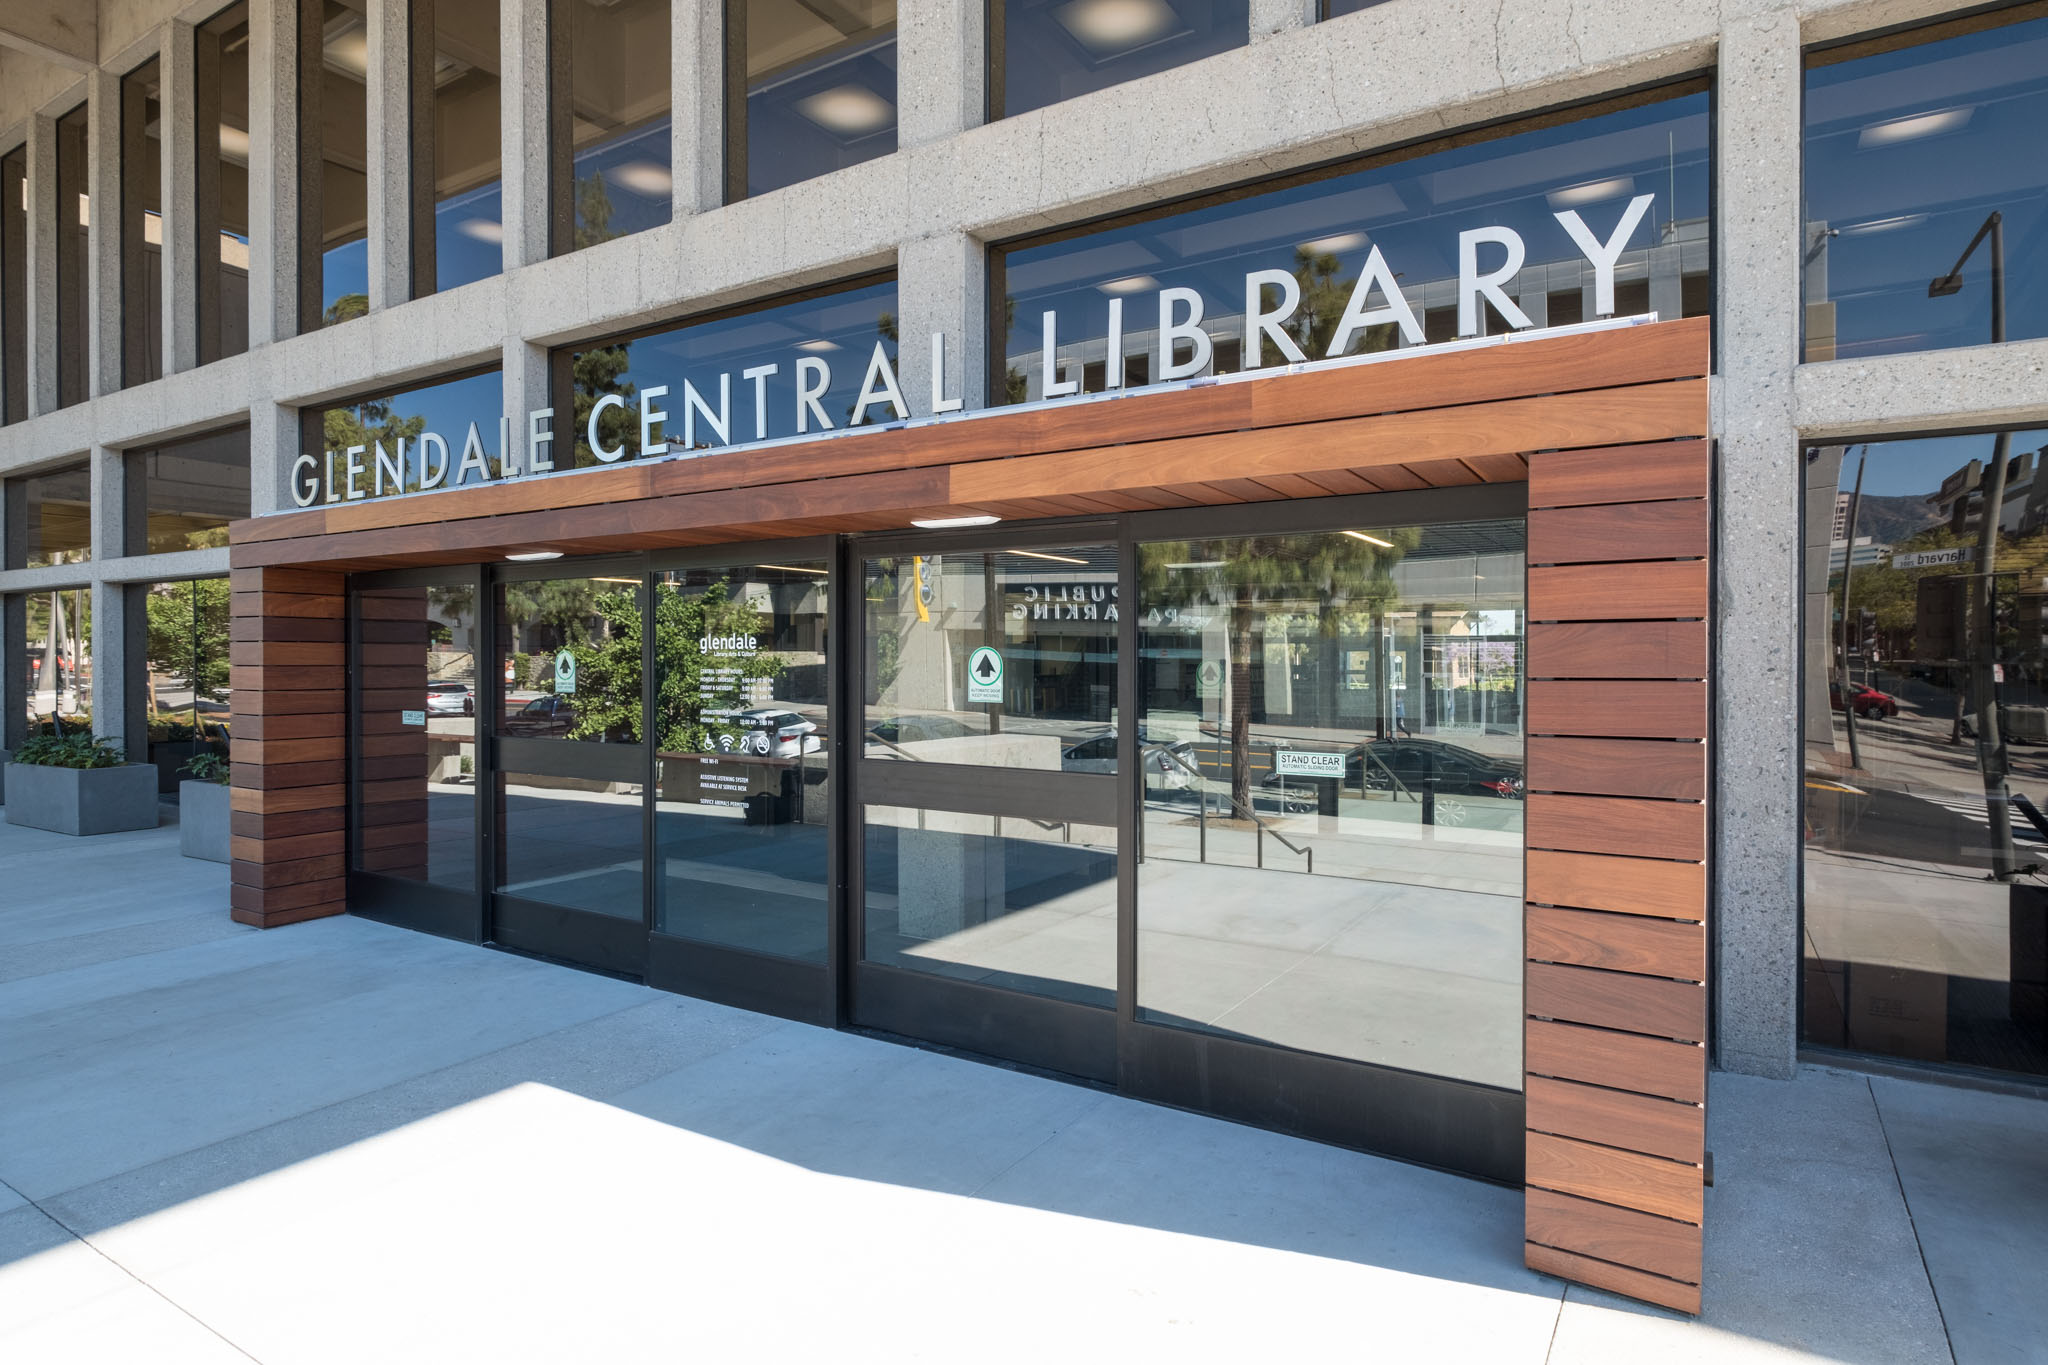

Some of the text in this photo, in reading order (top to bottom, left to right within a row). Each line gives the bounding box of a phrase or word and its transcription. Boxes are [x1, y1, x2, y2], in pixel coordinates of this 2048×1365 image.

[291, 193, 1655, 507] GLENDALE CENTRAL LIBRARY
[700, 633, 757, 654] glendale
[1281, 754, 1340, 765] STAND CLEAR
